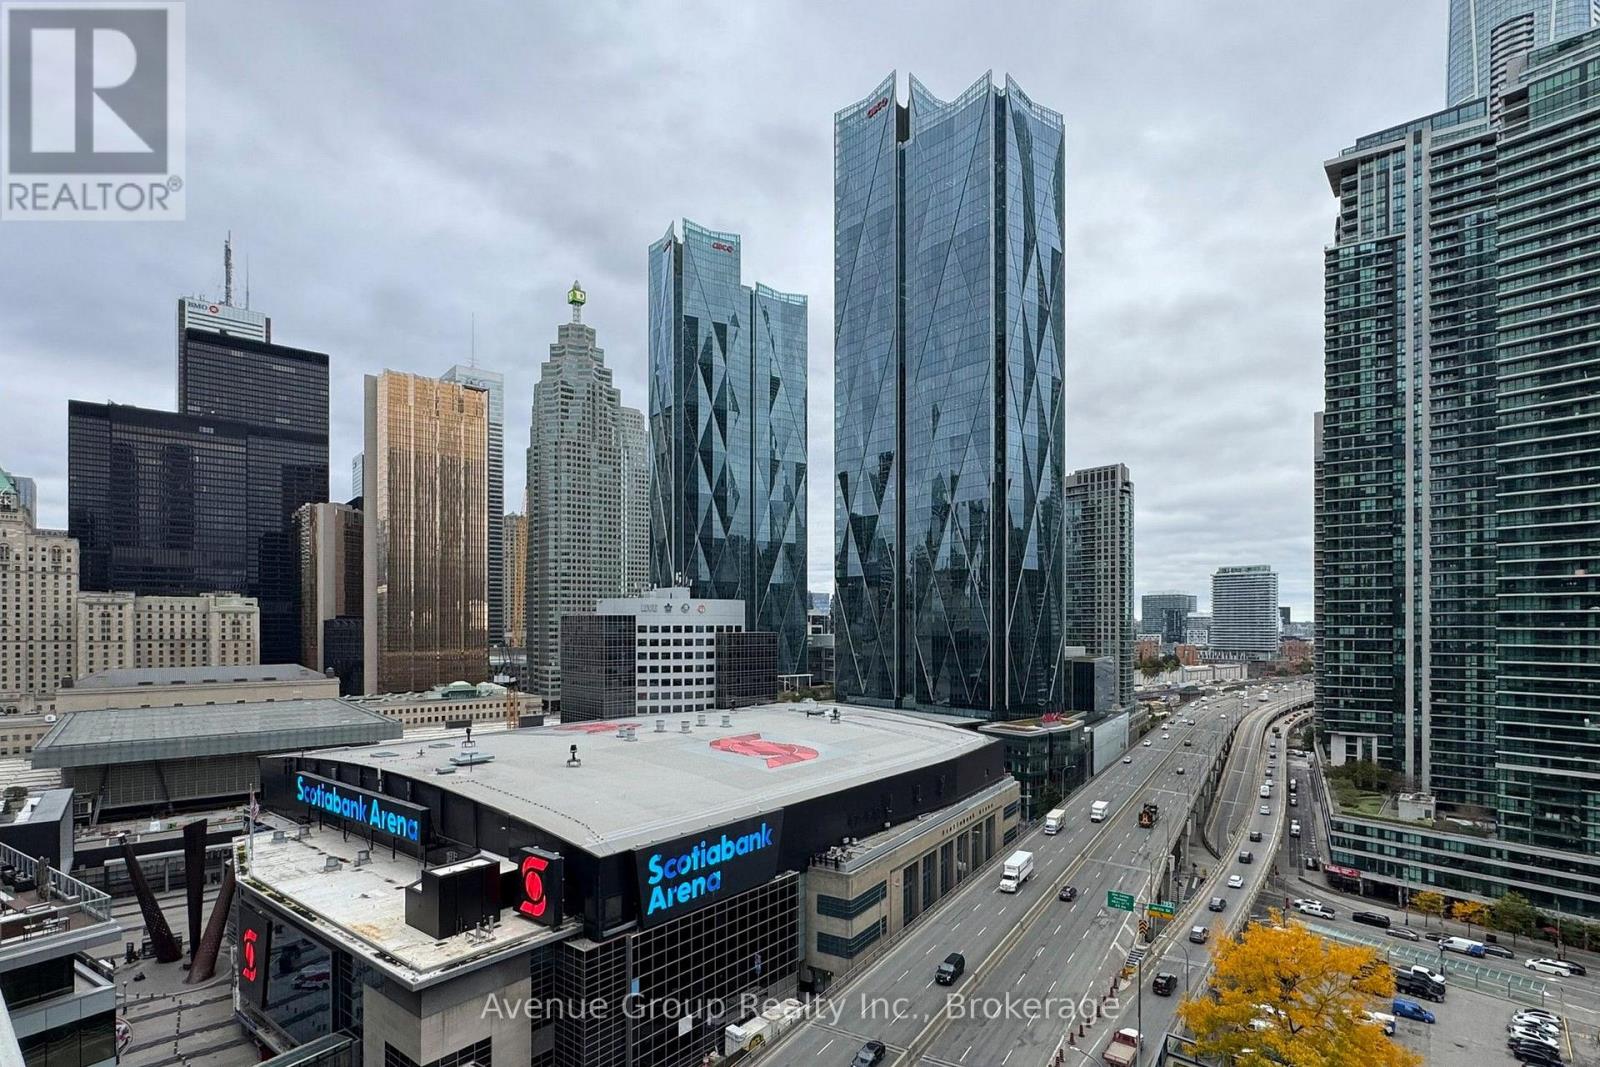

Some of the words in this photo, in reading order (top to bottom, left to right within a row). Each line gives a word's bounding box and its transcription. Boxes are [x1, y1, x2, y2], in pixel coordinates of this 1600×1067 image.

[296, 775, 367, 823] Scotiabank
[369, 799, 418, 841] Arena
[647, 822, 773, 885] Scotiabank
[646, 870, 721, 916] Arena
